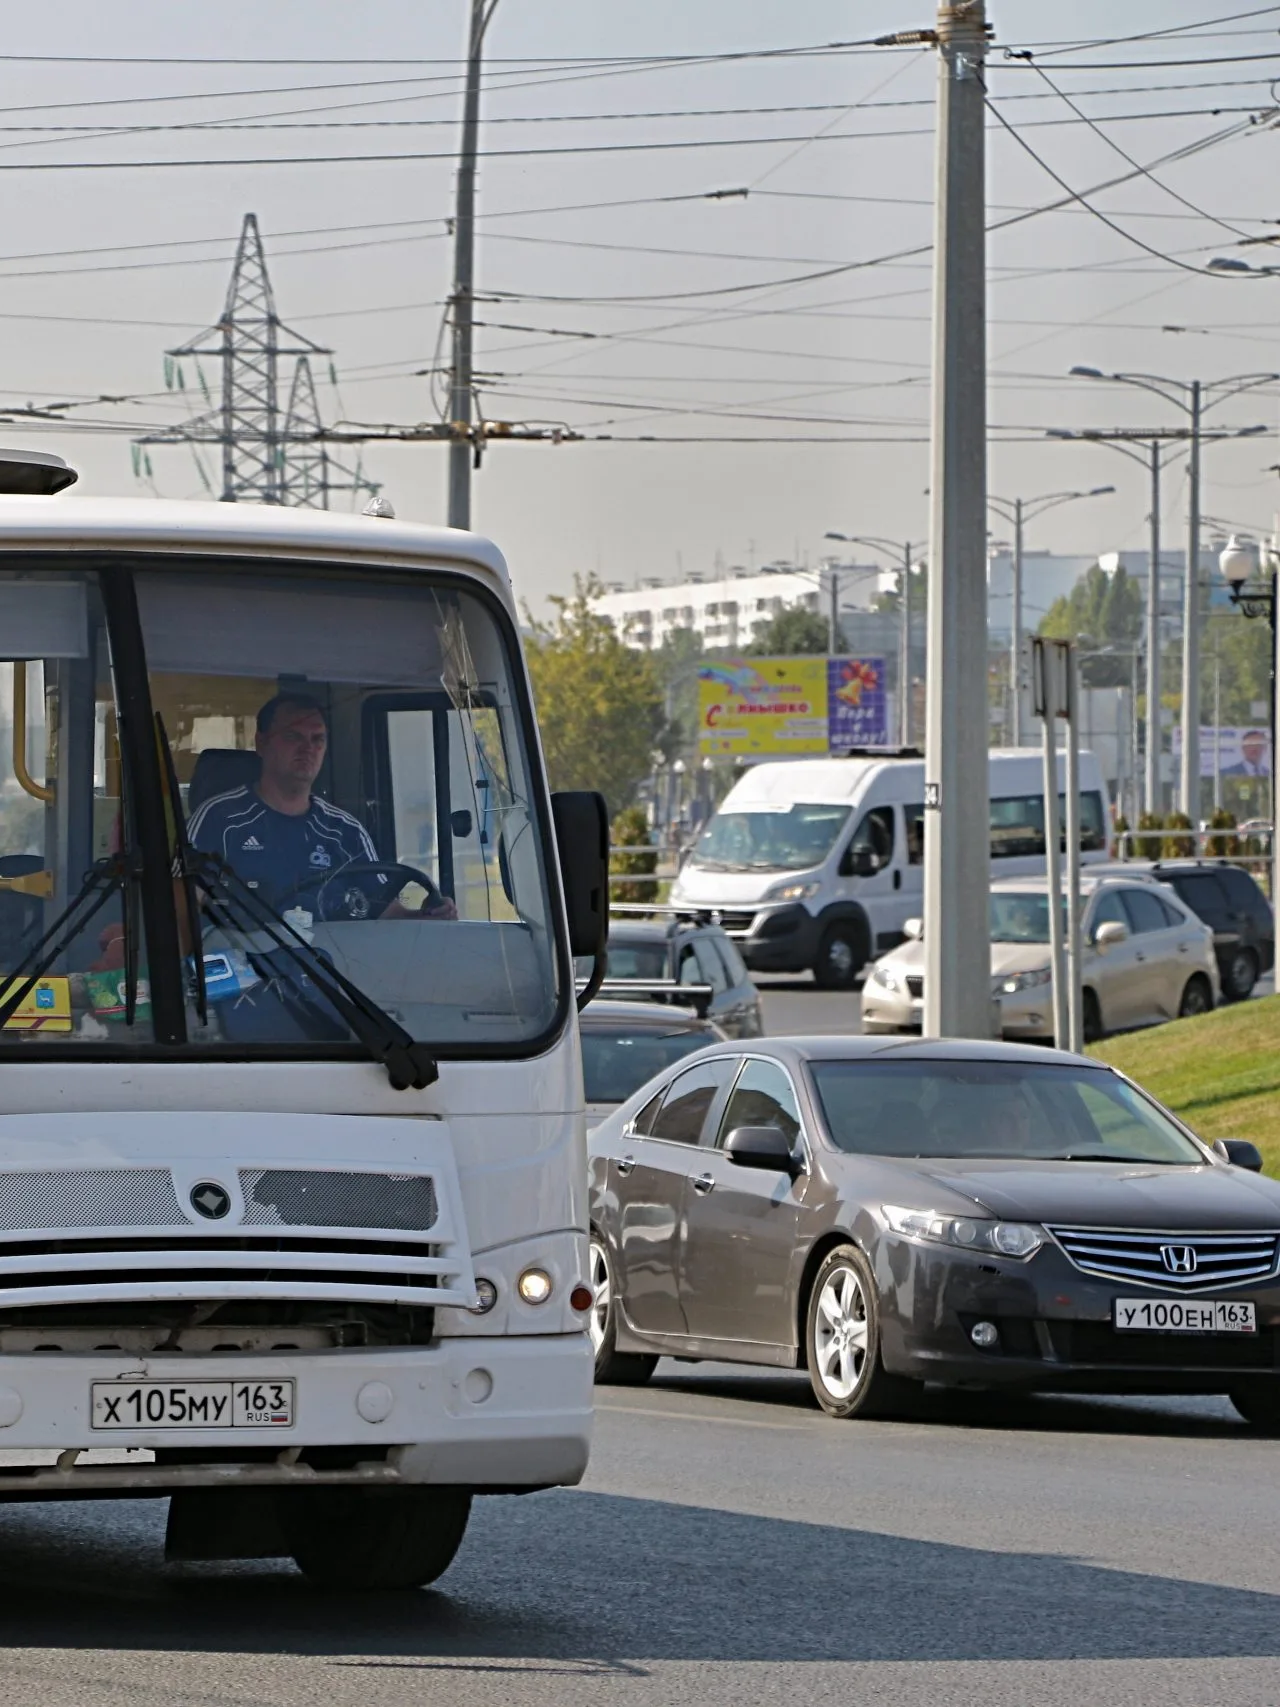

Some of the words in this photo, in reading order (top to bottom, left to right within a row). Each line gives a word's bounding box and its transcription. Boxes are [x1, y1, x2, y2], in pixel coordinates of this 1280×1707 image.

[1218, 1305, 1249, 1322] 163
[237, 1386, 283, 1411] 163
[247, 1413, 269, 1421] RUS
